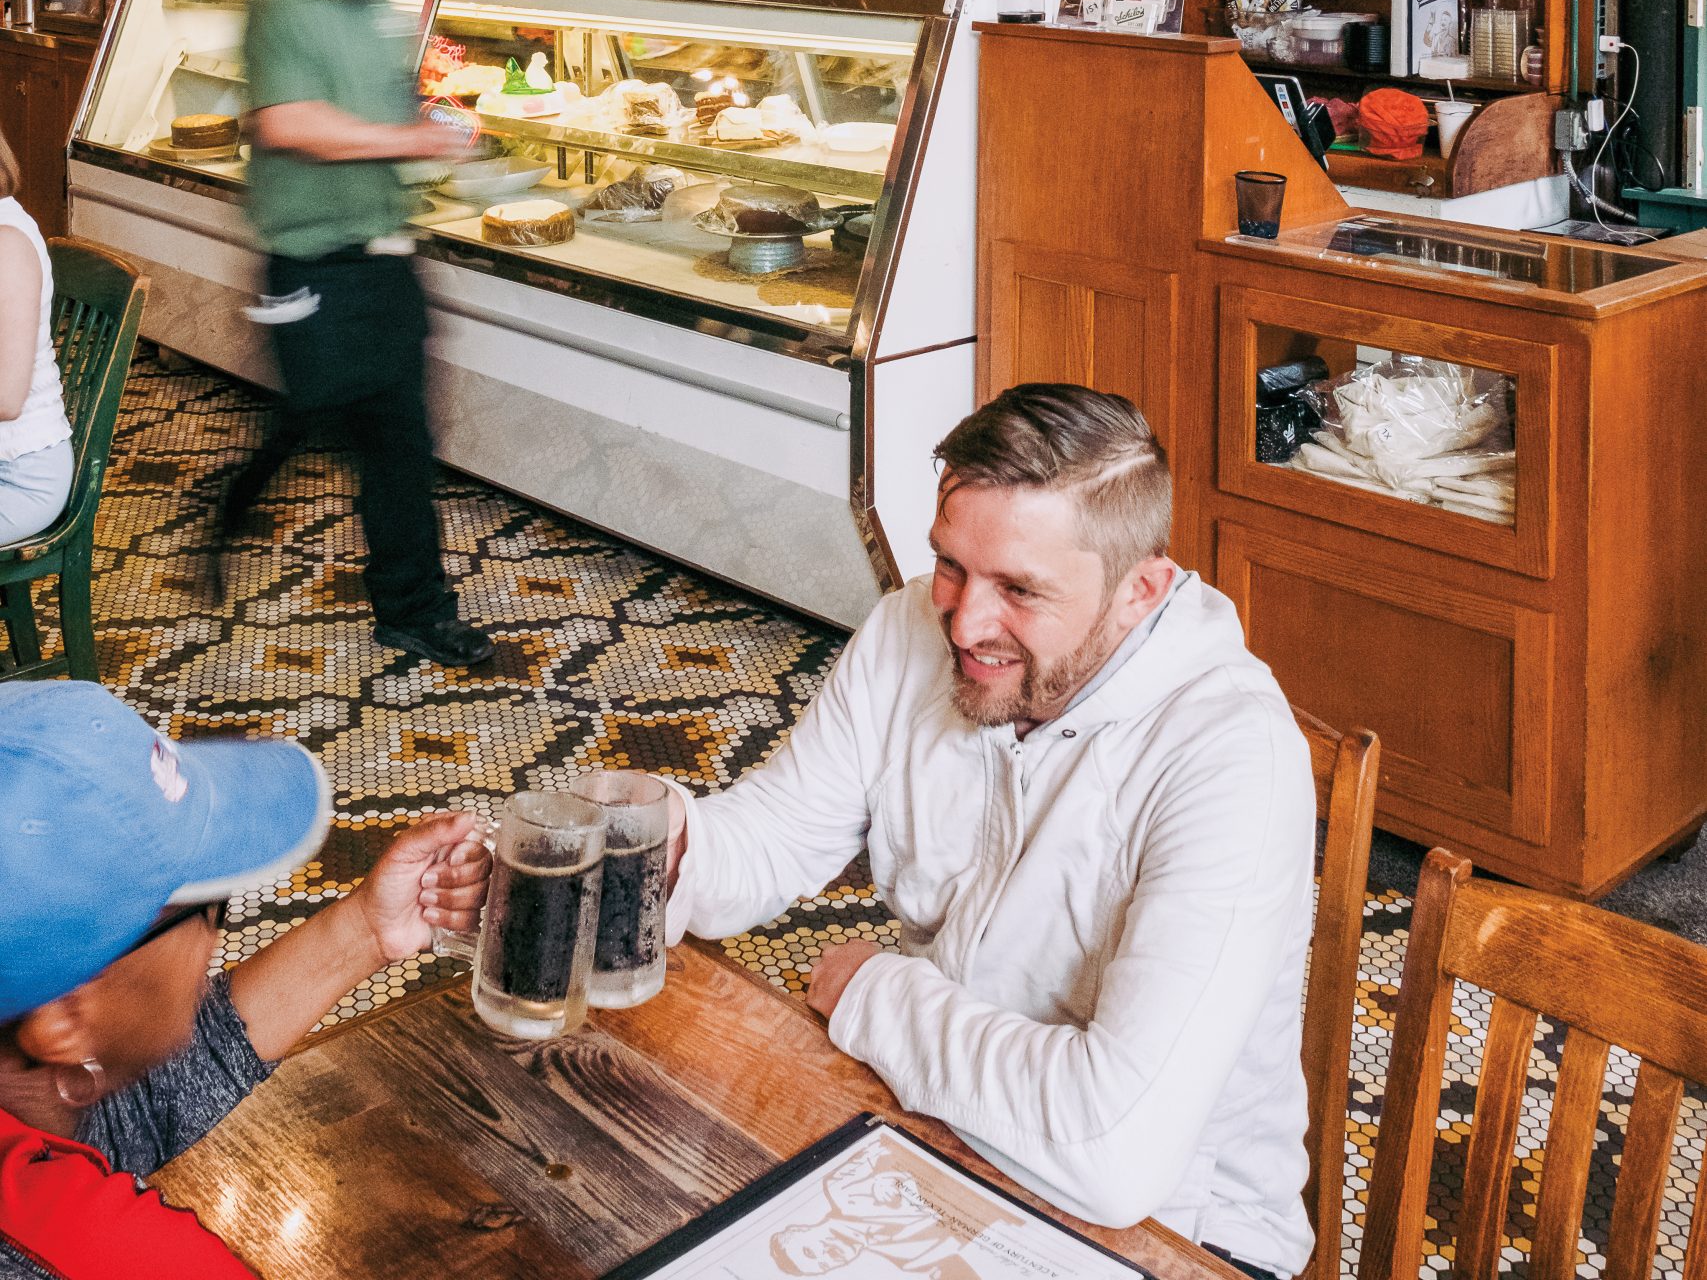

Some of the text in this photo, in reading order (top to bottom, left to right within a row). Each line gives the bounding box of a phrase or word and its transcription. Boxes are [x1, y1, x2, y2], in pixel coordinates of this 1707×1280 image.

[1114, 6, 1145, 25] Schilo's
[989, 1238, 1006, 1252] OF
[1003, 1244, 1051, 1278] CENTURY
